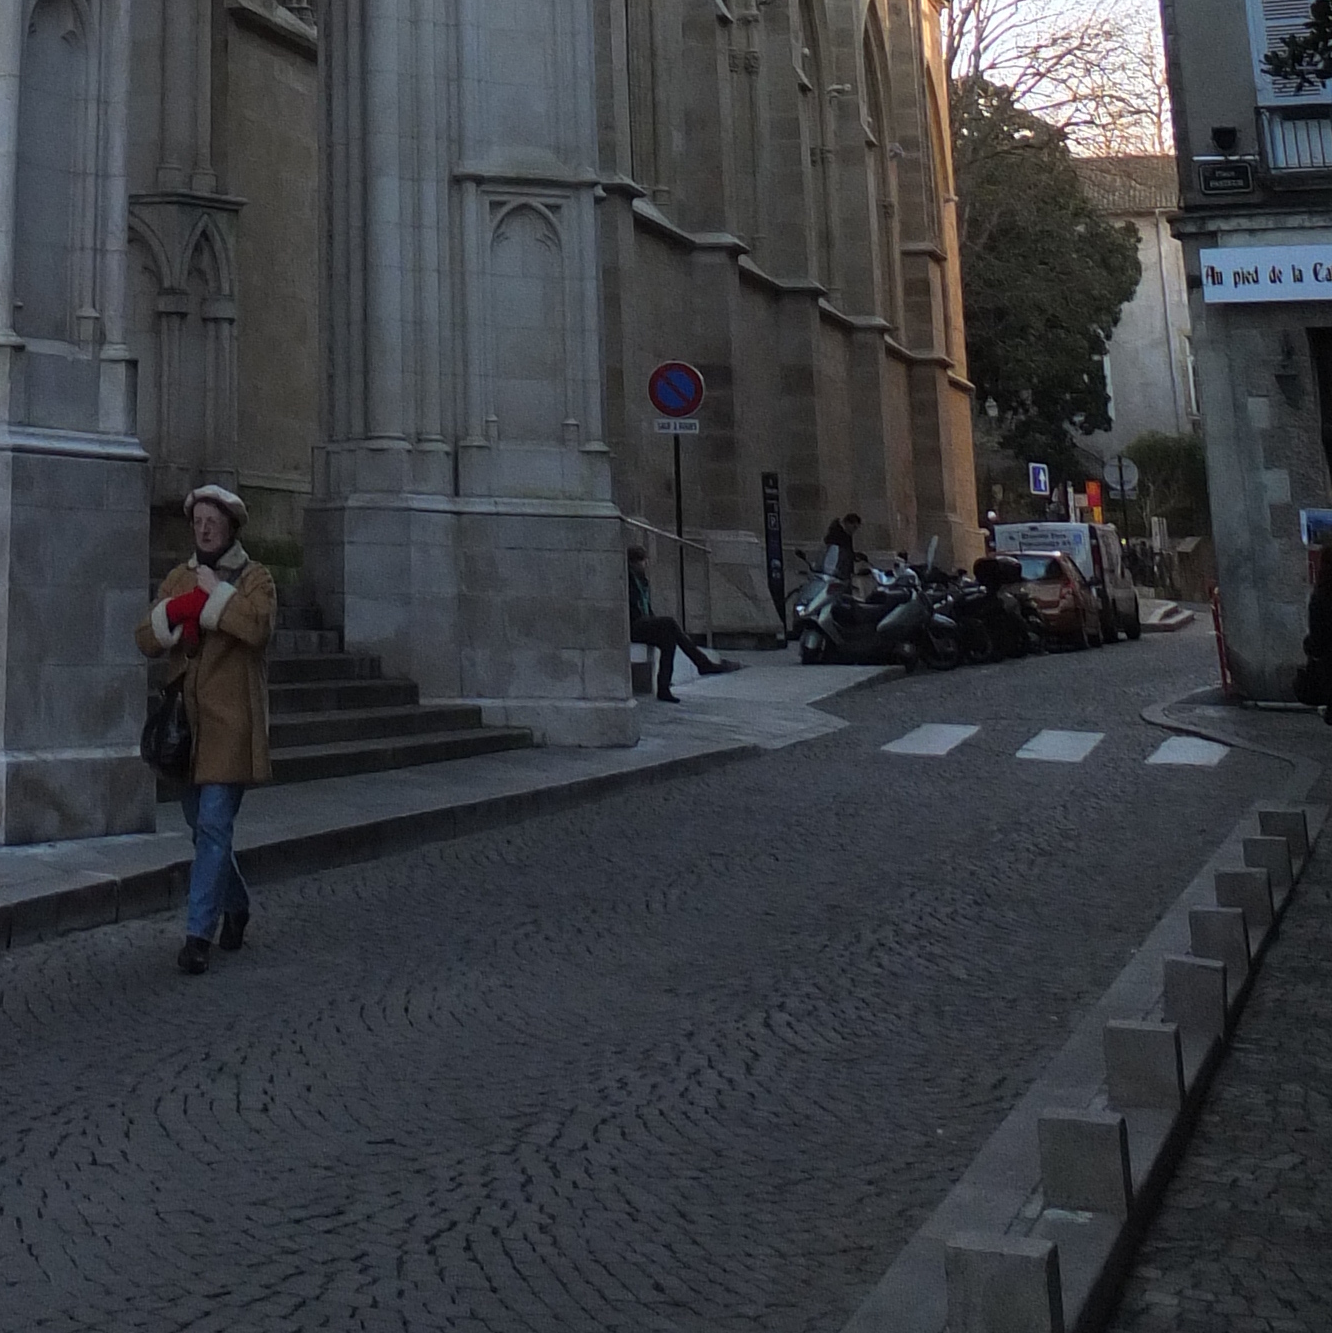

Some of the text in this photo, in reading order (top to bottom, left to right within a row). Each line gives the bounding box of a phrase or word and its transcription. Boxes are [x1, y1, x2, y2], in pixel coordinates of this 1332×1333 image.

[1204, 264, 1223, 286] Au
[1232, 264, 1259, 289] pied
[1269, 264, 1283, 284] de
[1291, 263, 1304, 283] la
